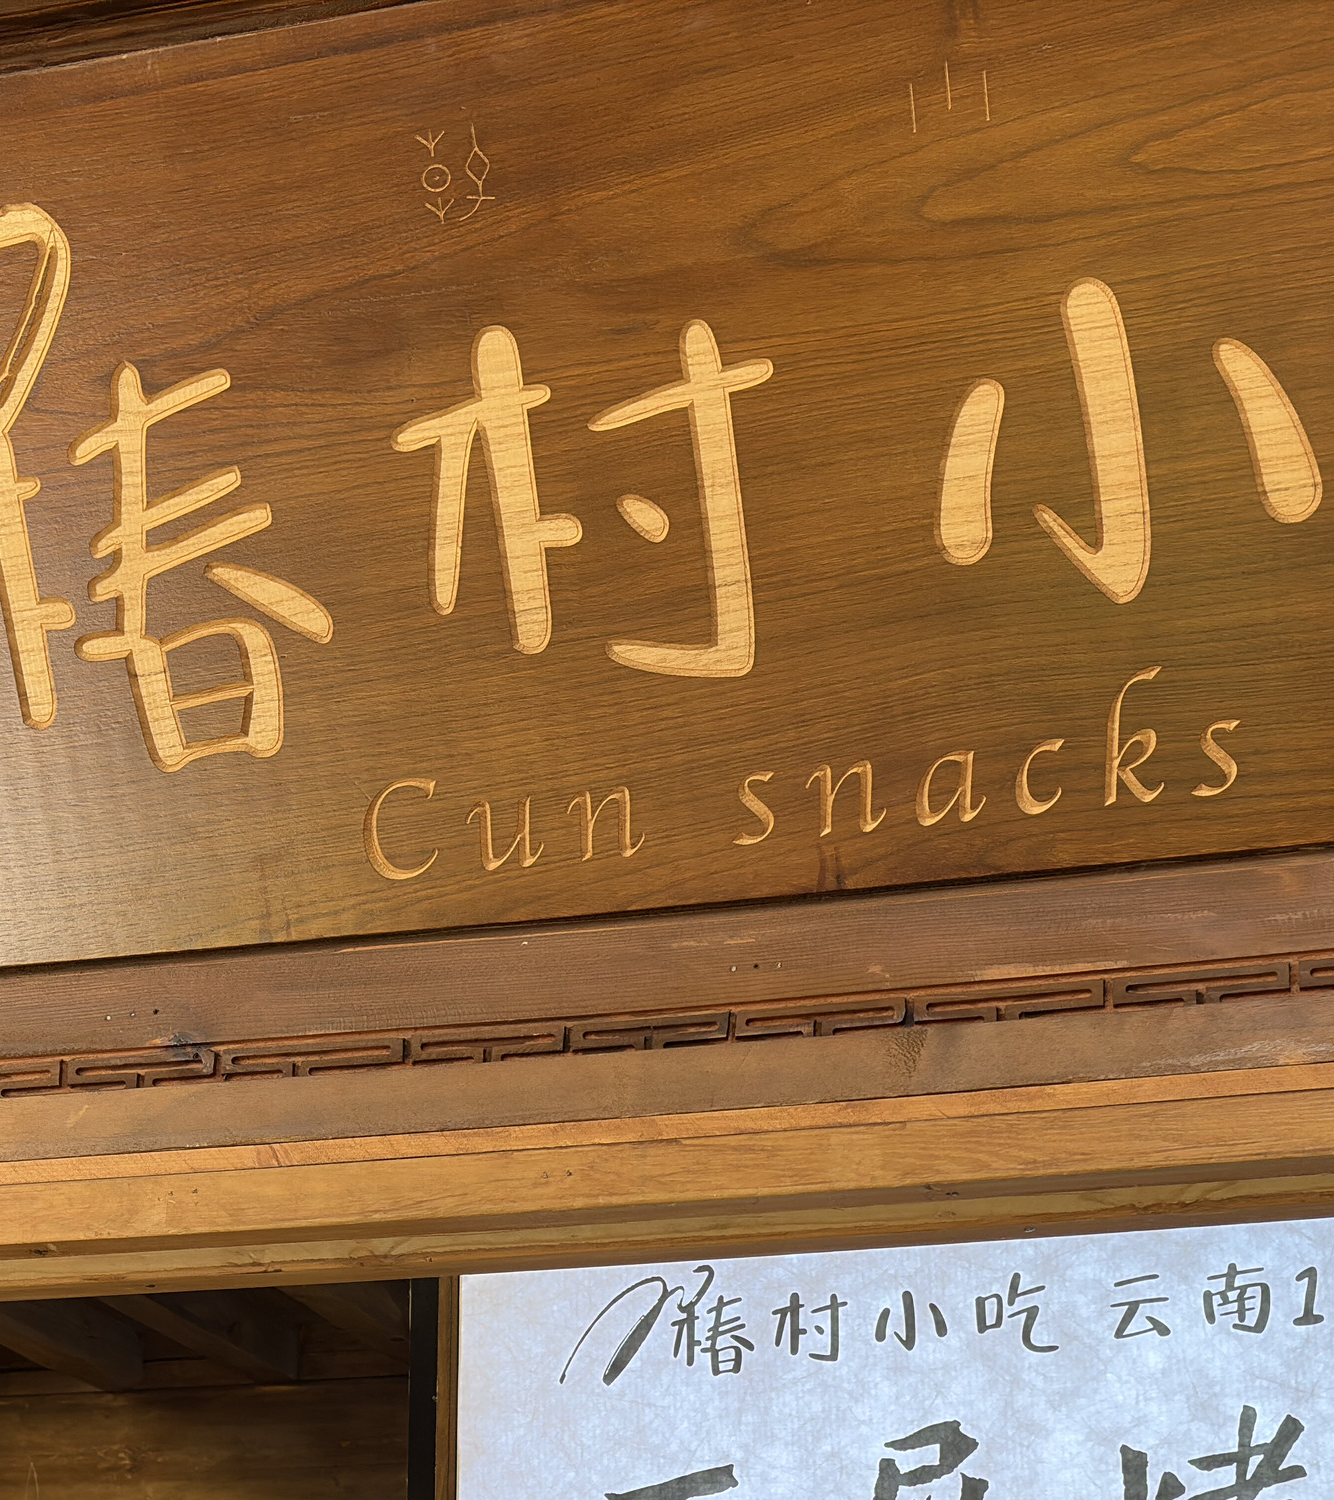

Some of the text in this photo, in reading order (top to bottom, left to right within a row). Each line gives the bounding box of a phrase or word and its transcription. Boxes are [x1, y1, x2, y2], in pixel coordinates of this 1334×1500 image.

[363, 665, 1242, 881] Cun snacks
[559, 1265, 1060, 1386] 椿村小吃
